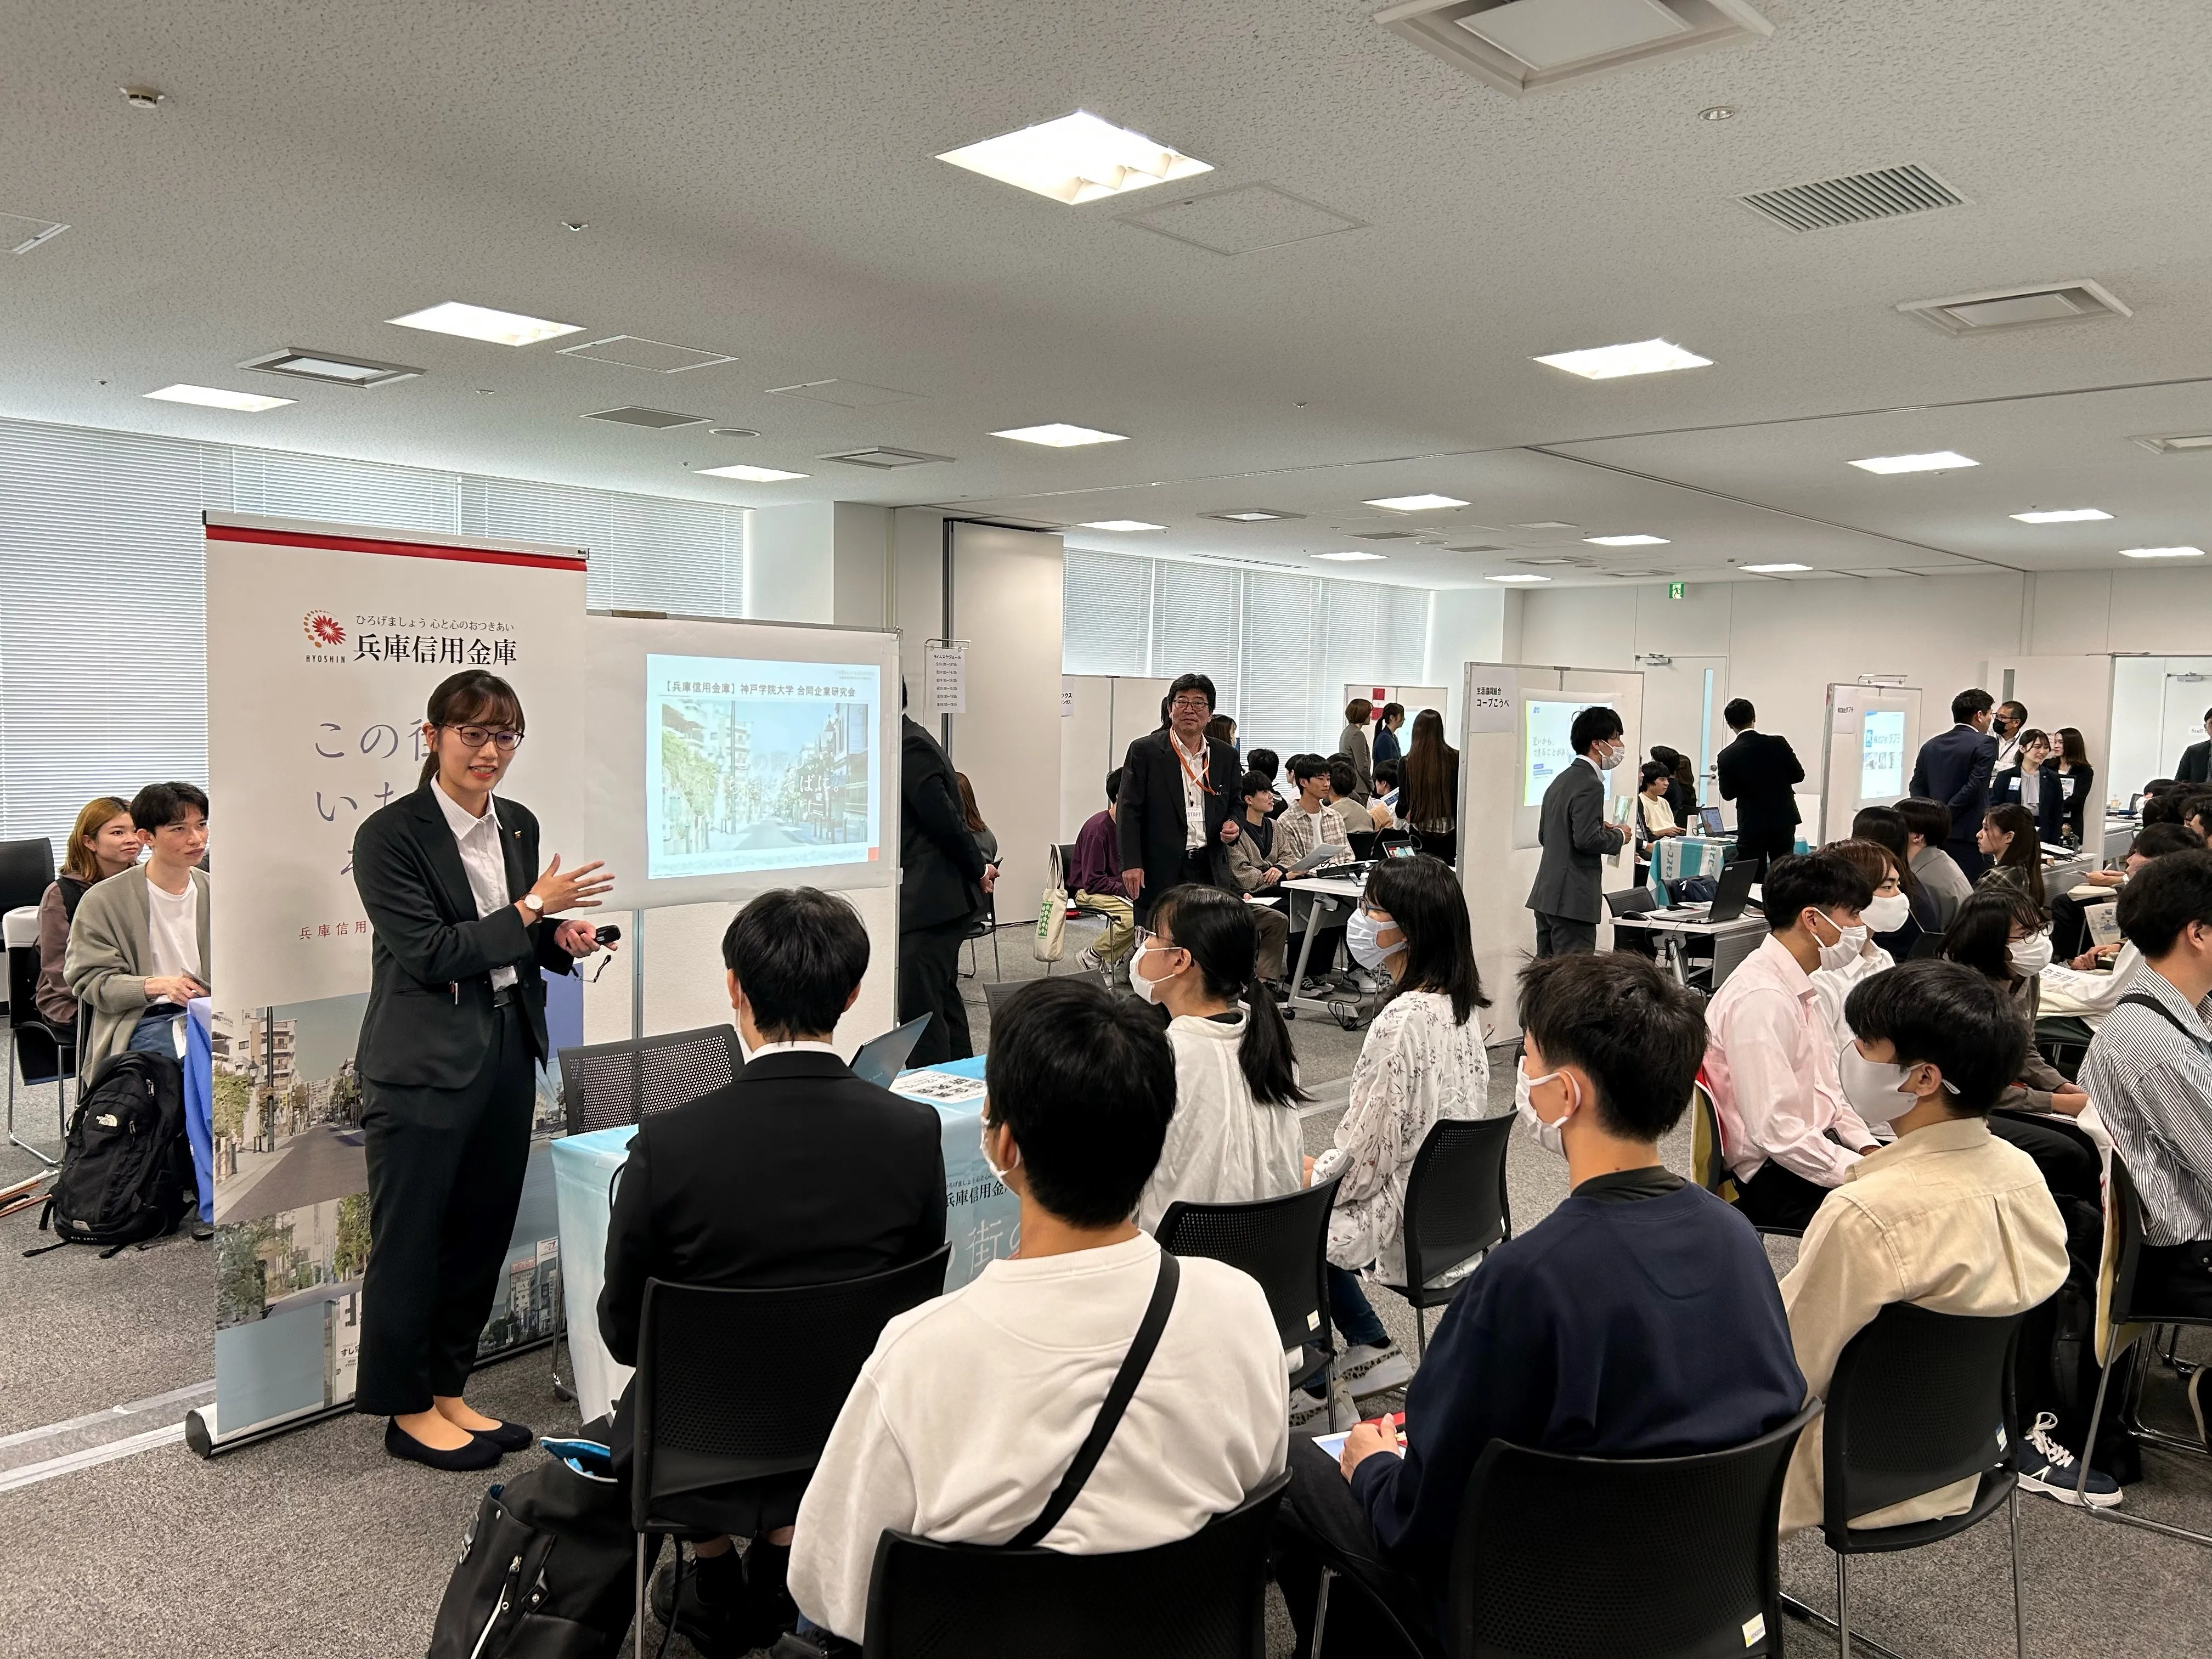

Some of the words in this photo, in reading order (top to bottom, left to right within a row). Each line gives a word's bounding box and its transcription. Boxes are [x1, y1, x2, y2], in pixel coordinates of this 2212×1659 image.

[356, 614, 426, 628] ひろげましょう
[430, 618, 515, 632] 心と心のおつきあい
[353, 633, 517, 665] 兵庫信用金庫
[306, 654, 346, 663] HYOSHIN
[667, 680, 735, 694] 【兵庫信用金庫】
[740, 684, 794, 696] 神戸学院大学
[797, 686, 856, 697] 合同企業研究会
[1476, 687, 1502, 695] 生活協同組合
[1476, 698, 1509, 708] コープこうべ
[299, 921, 366, 940] 兵庫信用
[946, 1181, 1007, 1207] 兵庫信用金
